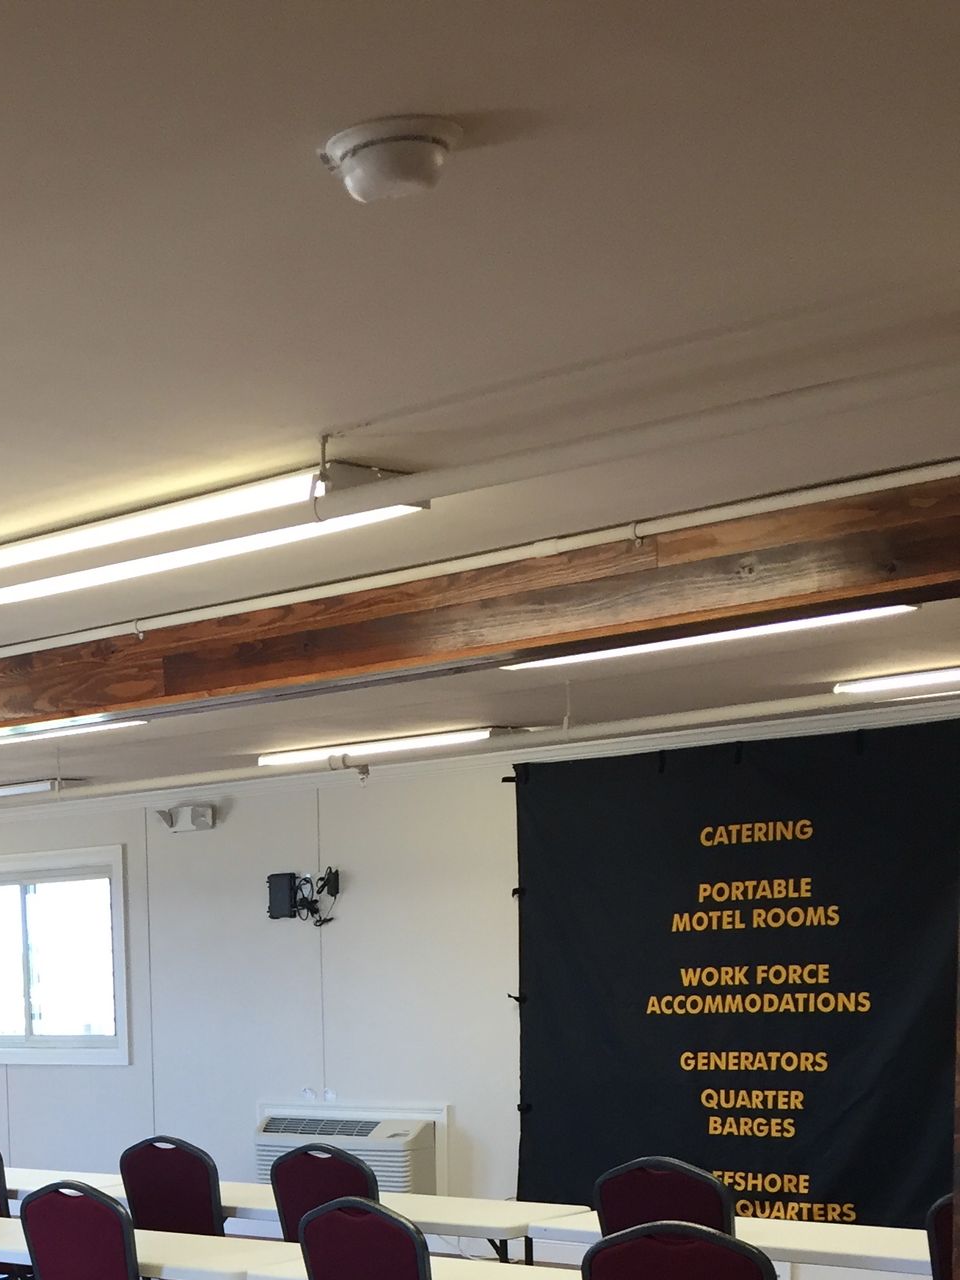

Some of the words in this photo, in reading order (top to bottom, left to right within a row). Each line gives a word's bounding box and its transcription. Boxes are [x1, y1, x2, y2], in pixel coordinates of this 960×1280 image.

[700, 819, 814, 847] CATERING
[698, 877, 812, 903] PORTABLE
[671, 910, 746, 932] MOTEL
[752, 905, 840, 928] ROOMS
[680, 966, 749, 987] WORK
[756, 963, 830, 985] FORCE
[646, 991, 871, 1015] ACCOMMODATIONS
[680, 1051, 829, 1072] GENERATORS
[700, 1088, 804, 1110] QUARTER
[708, 1116, 796, 1138] BARGES
[712, 1170, 810, 1194] FSHORE
[735, 1199, 857, 1222] QUARTERS
